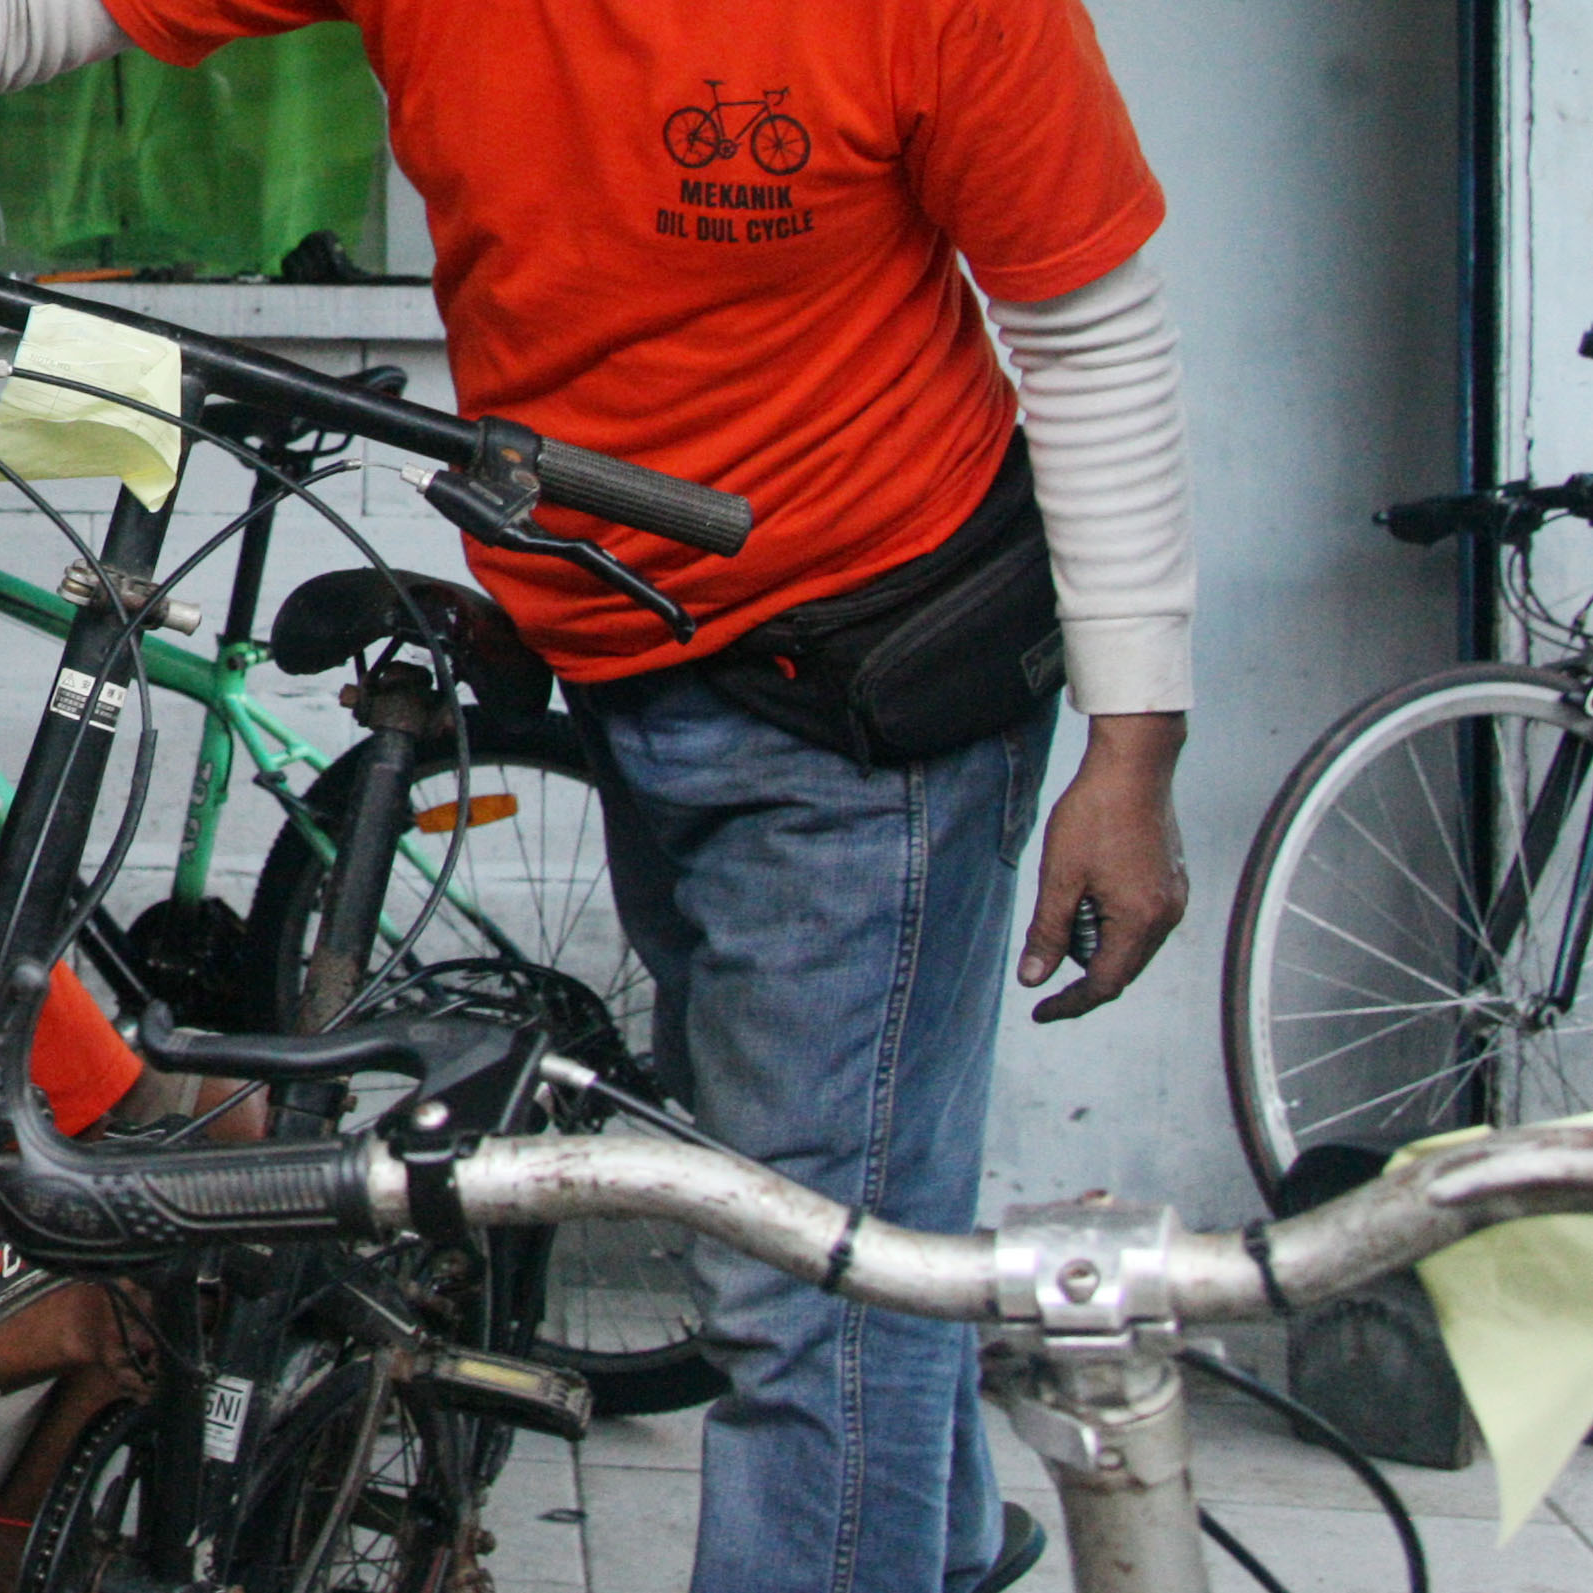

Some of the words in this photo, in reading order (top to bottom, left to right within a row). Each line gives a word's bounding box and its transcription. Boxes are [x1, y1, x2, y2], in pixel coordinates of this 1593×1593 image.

[680, 180, 793, 210] MEKANIK
[696, 216, 739, 243] DUL
[746, 209, 815, 243] CYCLE
